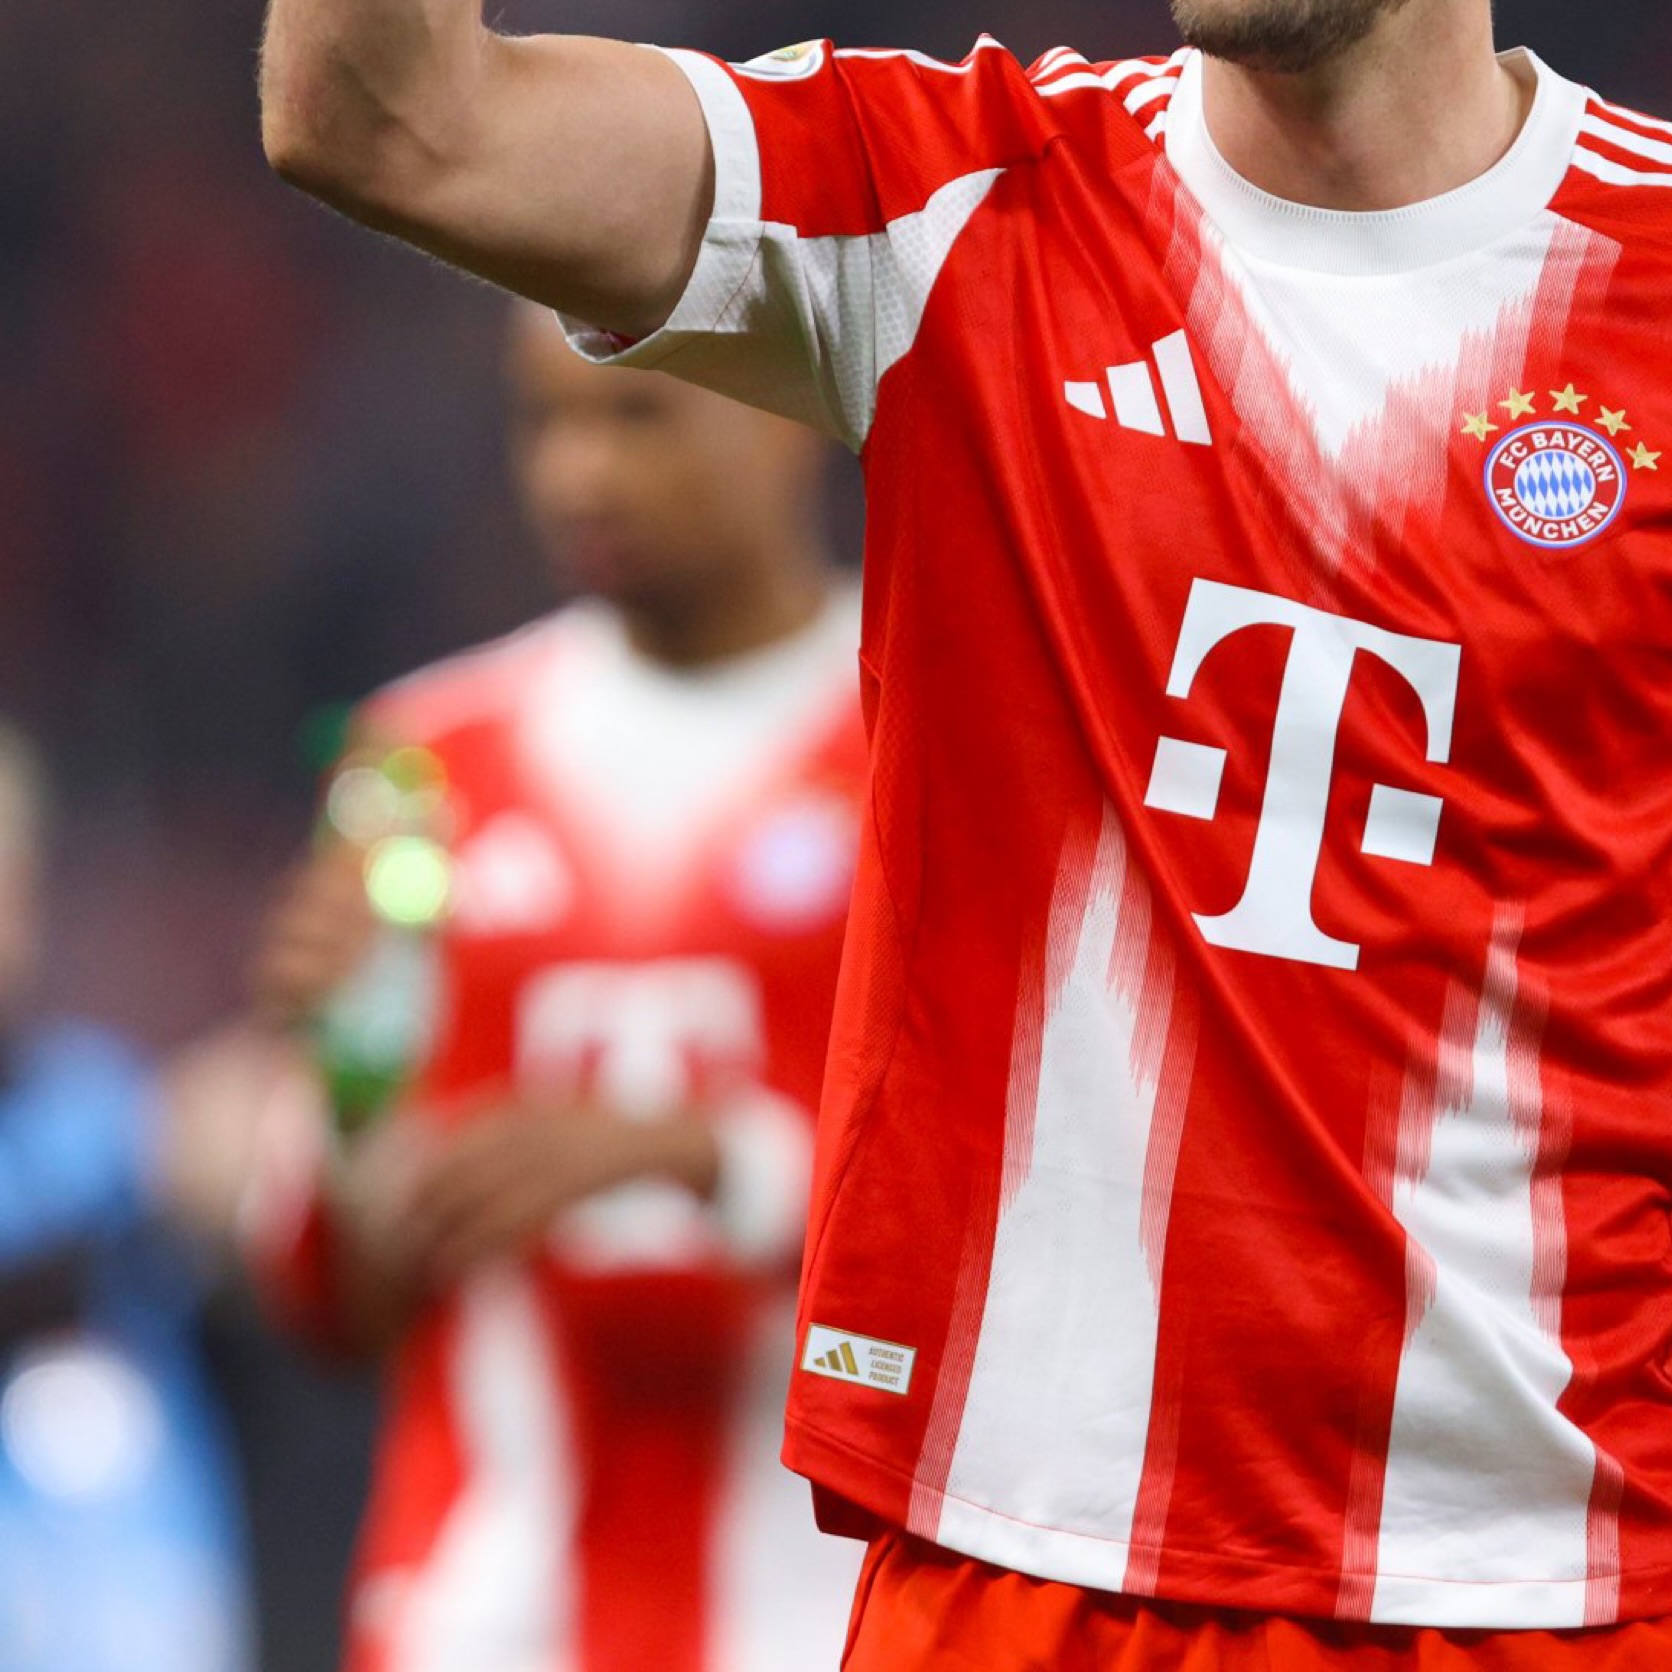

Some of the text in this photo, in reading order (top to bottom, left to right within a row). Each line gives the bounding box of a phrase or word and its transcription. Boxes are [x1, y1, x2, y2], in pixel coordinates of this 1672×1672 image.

[1499, 430, 1616, 483] FC BAYERN
[1165, 577, 1462, 972] T
